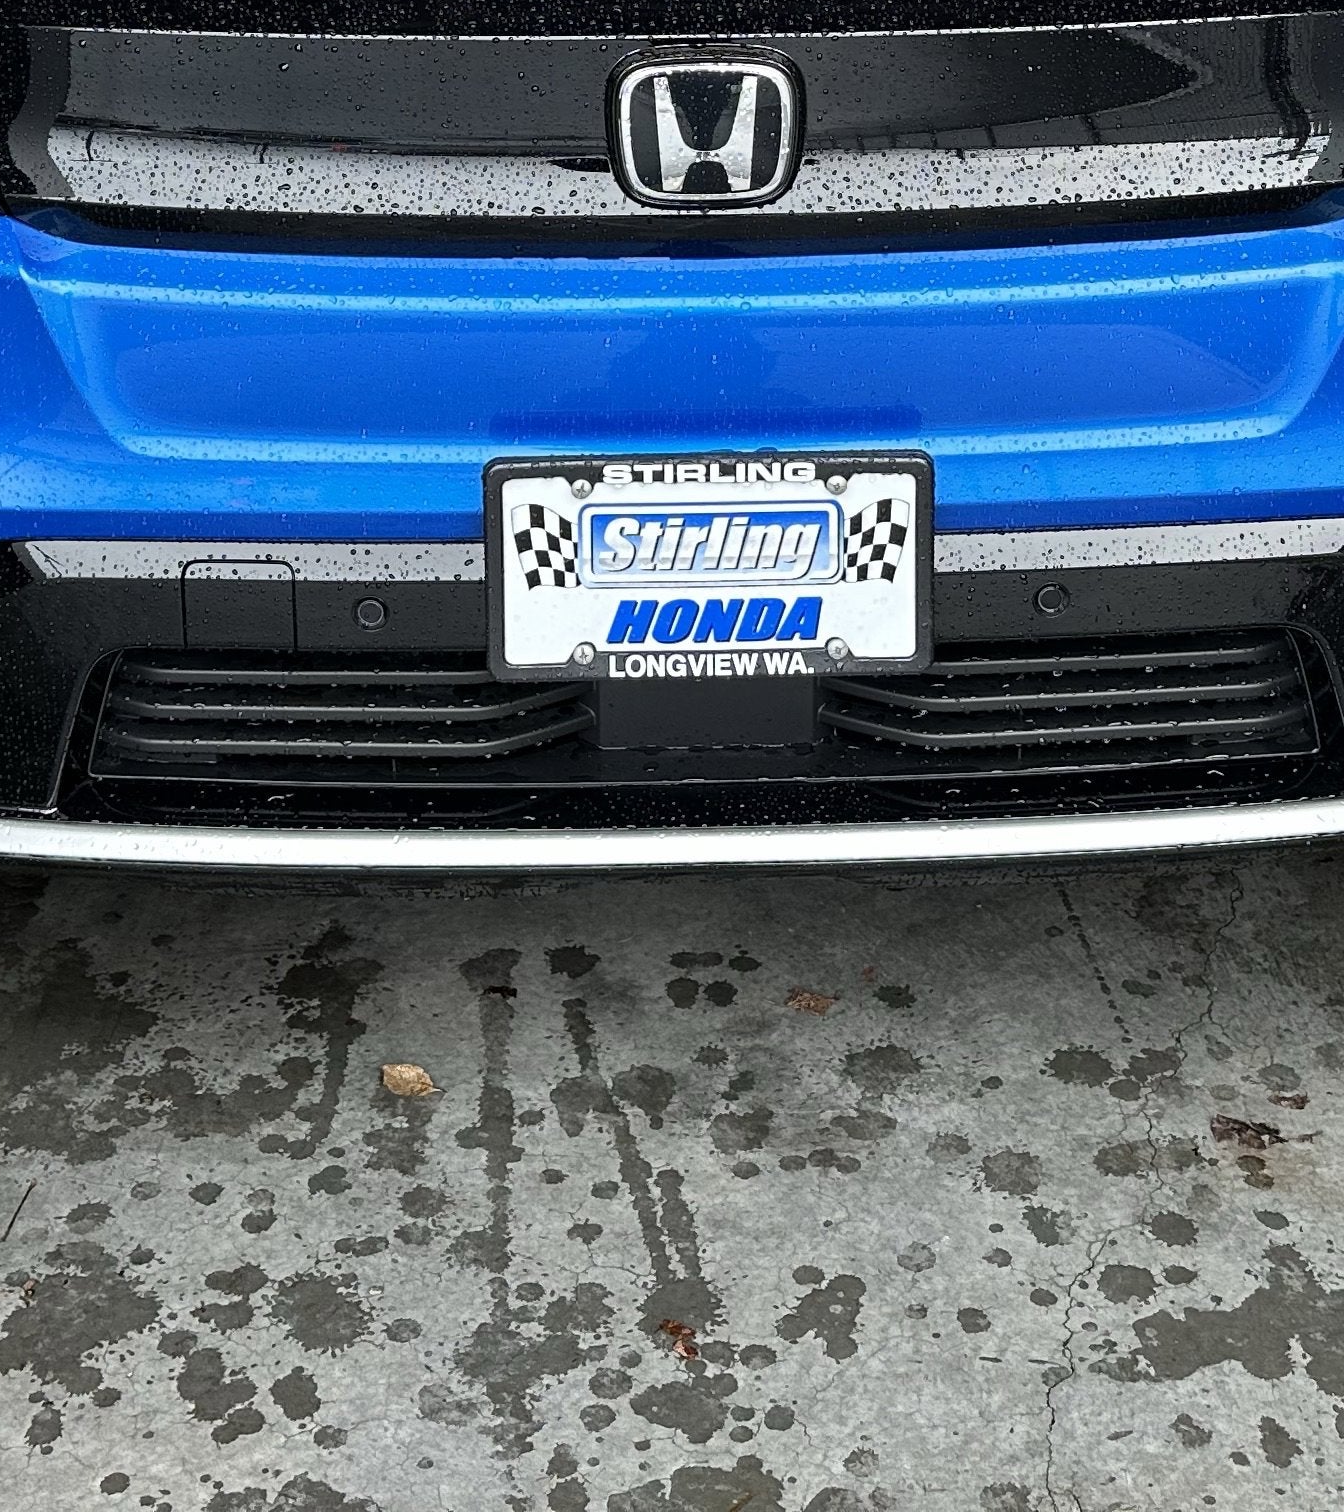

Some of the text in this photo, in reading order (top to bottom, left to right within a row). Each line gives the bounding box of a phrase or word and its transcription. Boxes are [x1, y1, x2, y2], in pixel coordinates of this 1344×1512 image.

[602, 462, 816, 484] STIRLING
[598, 516, 822, 576] Stirling
[606, 596, 823, 644] HONDA
[608, 651, 815, 678] LONGVIEW WA.
